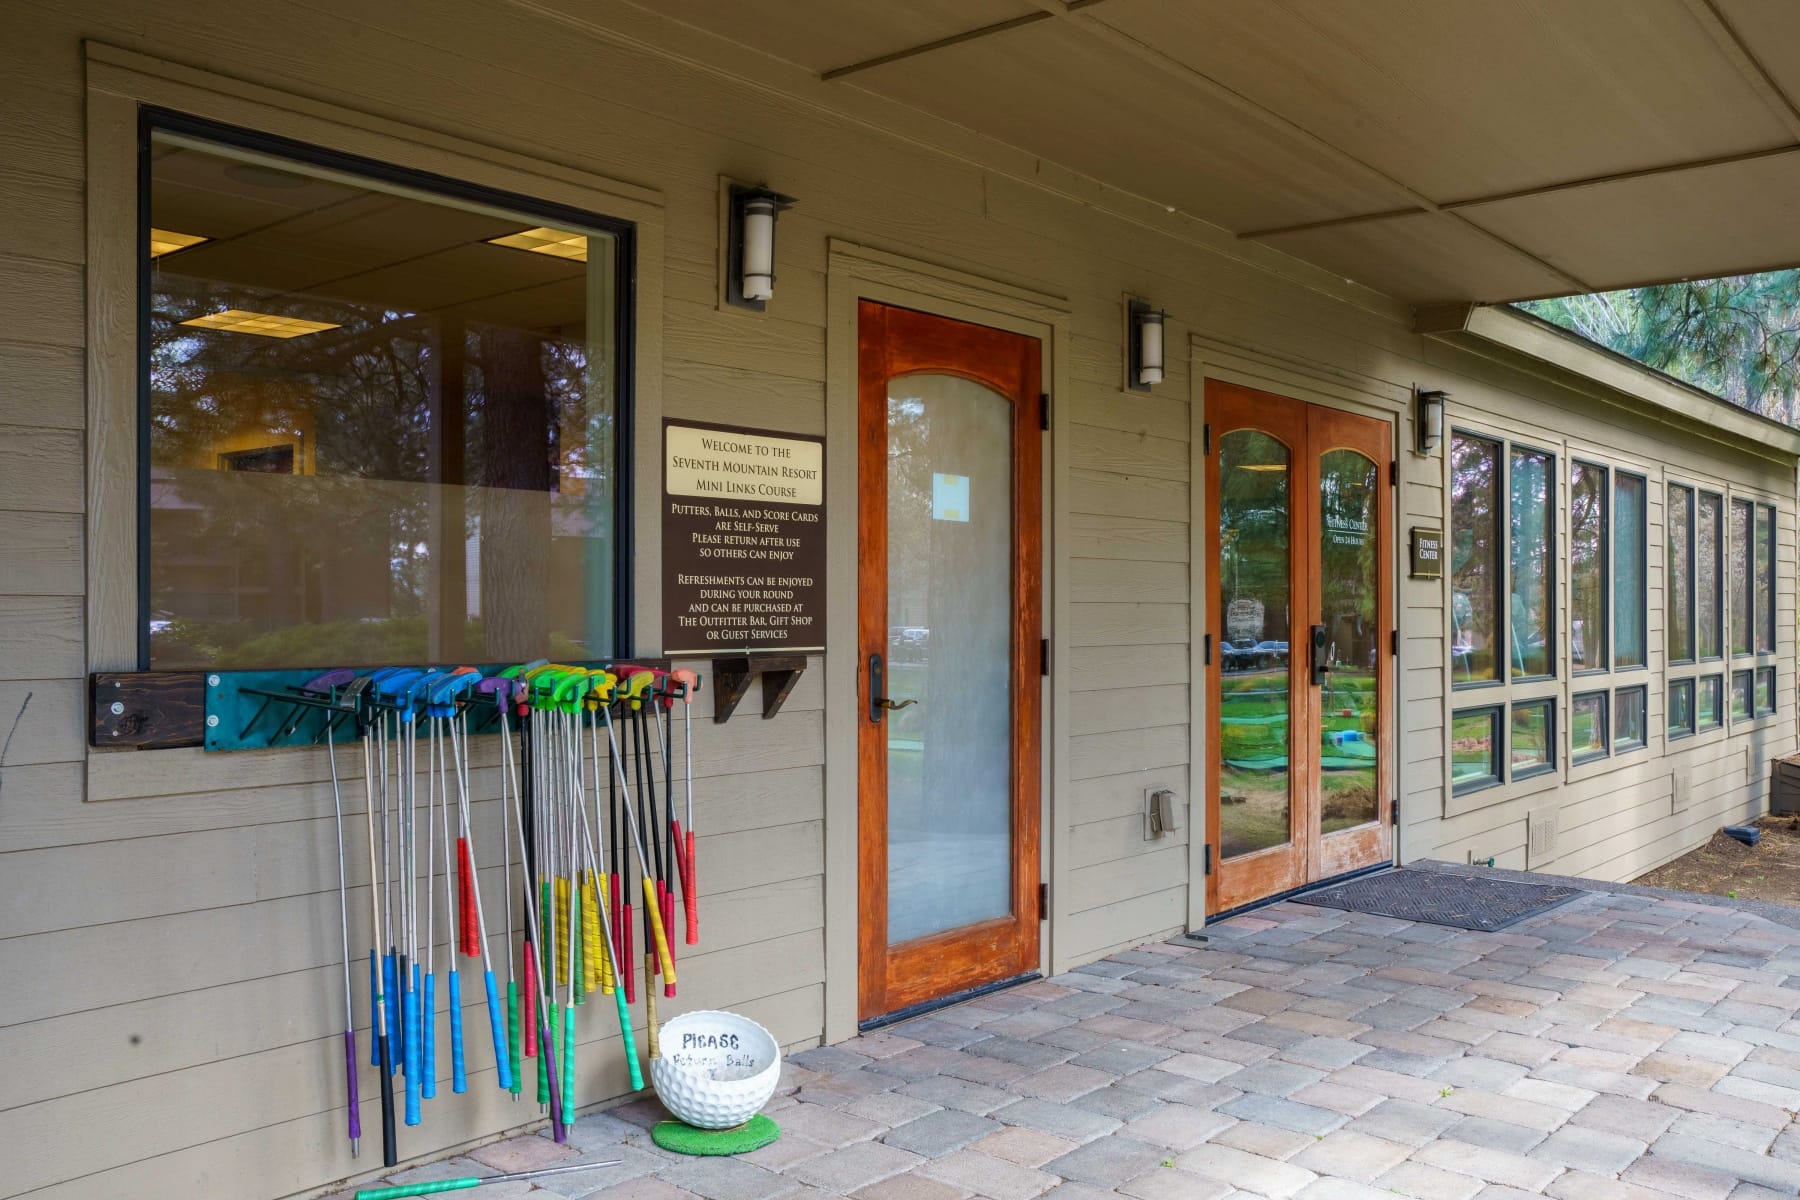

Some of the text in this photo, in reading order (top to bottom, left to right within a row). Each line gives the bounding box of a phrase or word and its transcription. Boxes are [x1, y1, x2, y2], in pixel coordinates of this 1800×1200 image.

[702, 438, 791, 458] WELCOME TO THE
[673, 456, 817, 480] SEVENTH MOUNTAIN RESORT
[696, 480, 796, 497] MINI LINKS COURSE
[672, 504, 818, 522] PUTTERS, BALLS, AND SCORE CARDS
[716, 521, 779, 533] ARE SELF-SERVE
[693, 533, 800, 547] PLEASE RETURN AFTER USE
[1420, 538, 1438, 550] FITNESS
[700, 548, 793, 561] SO OTHERS CAN ENJOY
[1420, 549, 1438, 560] CENTER
[678, 574, 813, 588] REFRESHMENTS CAN BE ENJOYED
[701, 590, 793, 599] DURING YOUR ROUND
[689, 604, 803, 612] AND CAN BE PURCHASED AT
[678, 616, 812, 626] THE OUTFITTER BAR, GIFT SHOP
[707, 629, 787, 639] OR GUEST SERVICES
[726, 1054, 755, 1067] Balls
